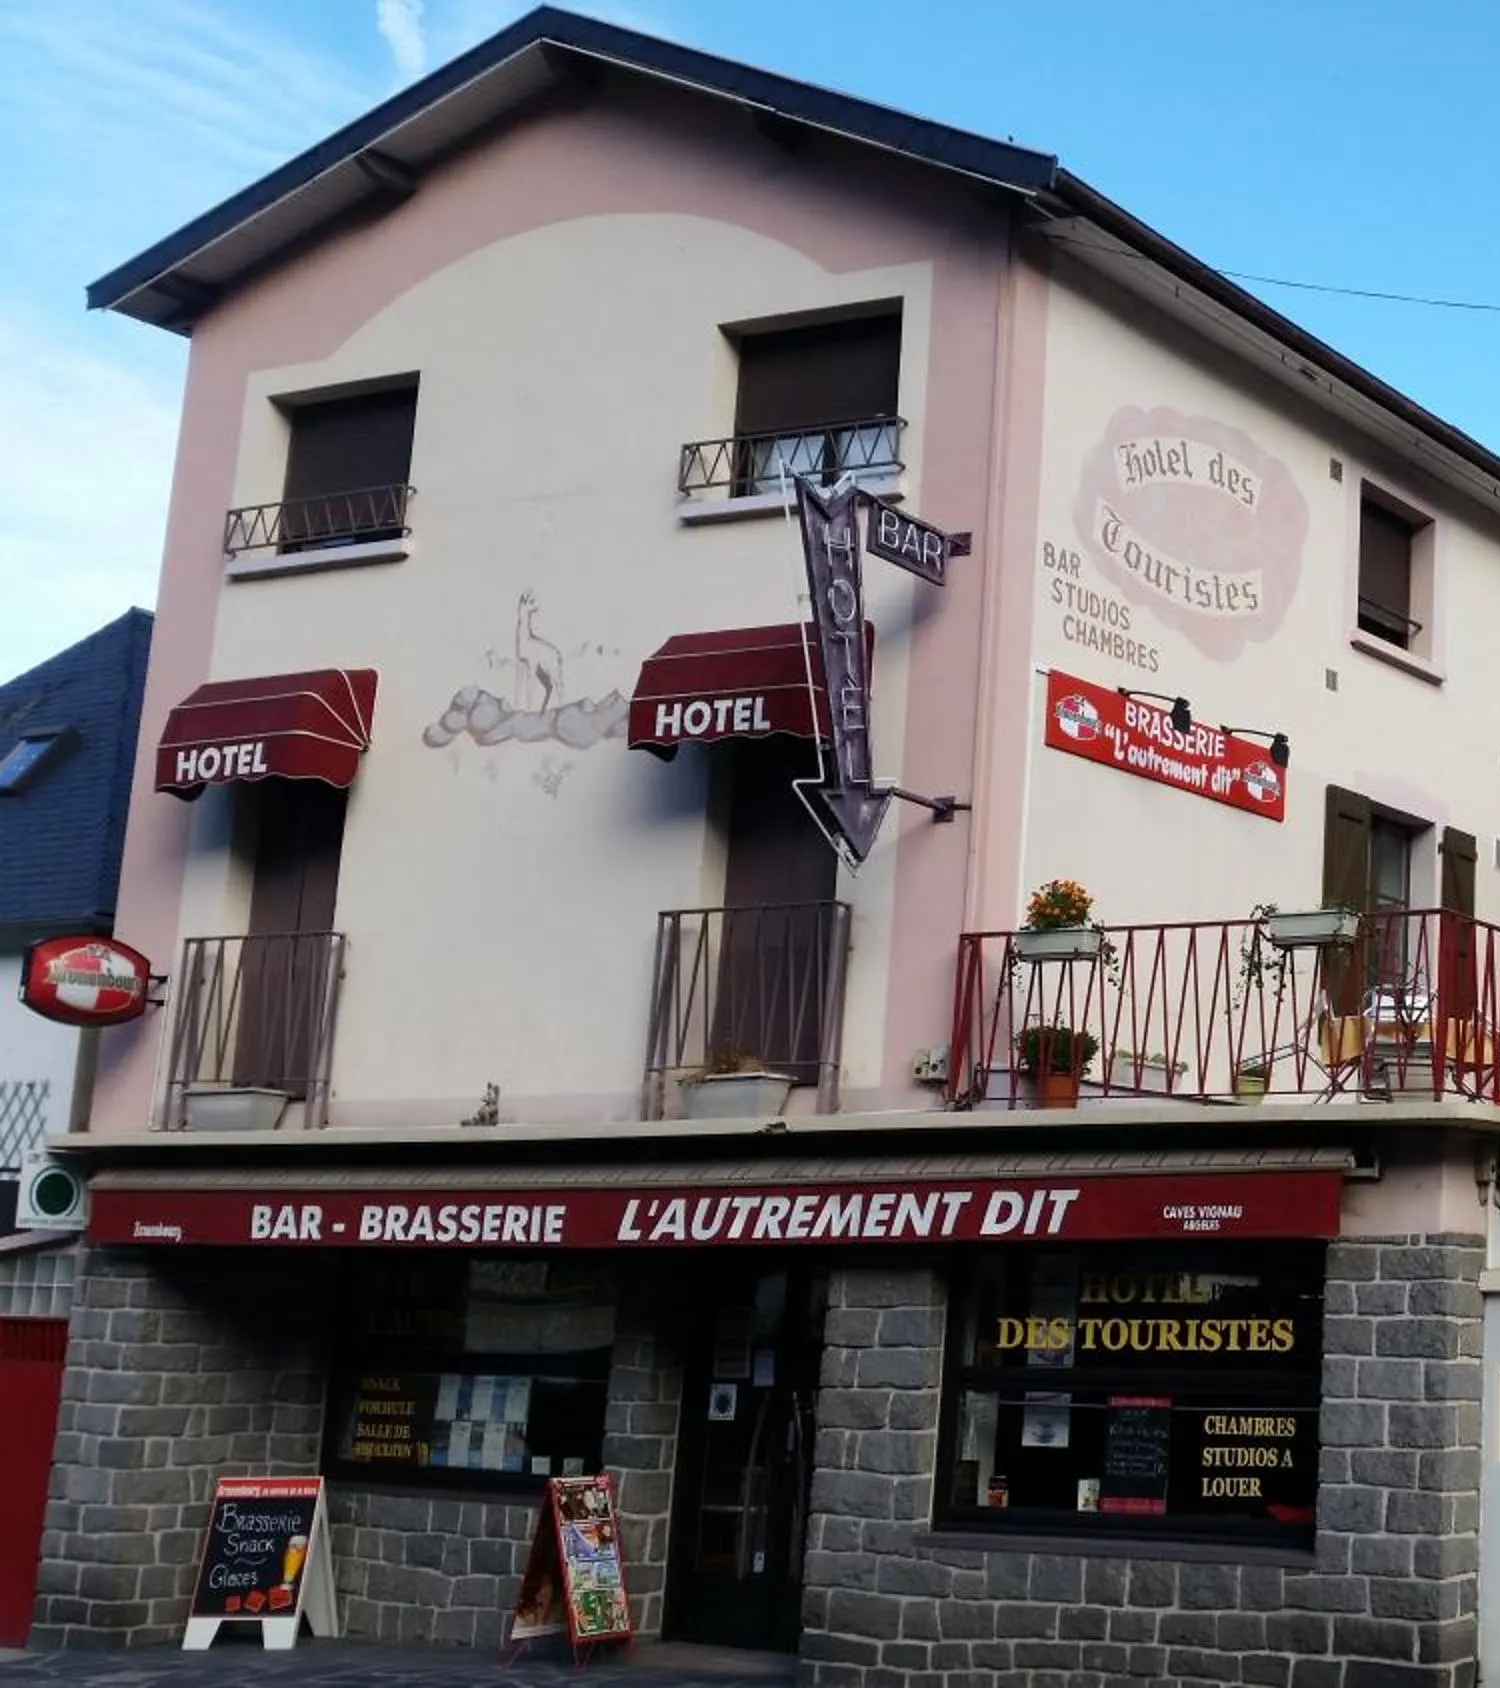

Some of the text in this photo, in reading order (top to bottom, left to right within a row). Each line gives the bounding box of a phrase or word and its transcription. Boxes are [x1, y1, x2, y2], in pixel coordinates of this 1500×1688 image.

[1208, 452, 1254, 505] des
[877, 508, 943, 571] BAR
[1101, 504, 1259, 612] Touristes
[1043, 541, 1081, 578] BAR
[1051, 579, 1130, 630] STUDIOS
[822, 520, 866, 783] HOTEL
[1063, 615, 1159, 672] CHAMBRES
[655, 696, 771, 737] HOTEL
[175, 741, 268, 782] HOTEL
[250, 1204, 323, 1240] BAR
[359, 1205, 567, 1243] BRASSERIE
[617, 1189, 1080, 1241] L'AUTREMENT DIT
[1163, 1205, 1243, 1219] CAVES VIGNAU
[995, 1317, 1297, 1352] DES TOURISTES
[1204, 1415, 1296, 1437] CHAMBRES
[1202, 1447, 1293, 1467] STUDIOS A
[1202, 1477, 1262, 1497] LOUER
[217, 1503, 301, 1533] Brasserie
[223, 1533, 275, 1556] Snack
[209, 1563, 259, 1590] Glaces
